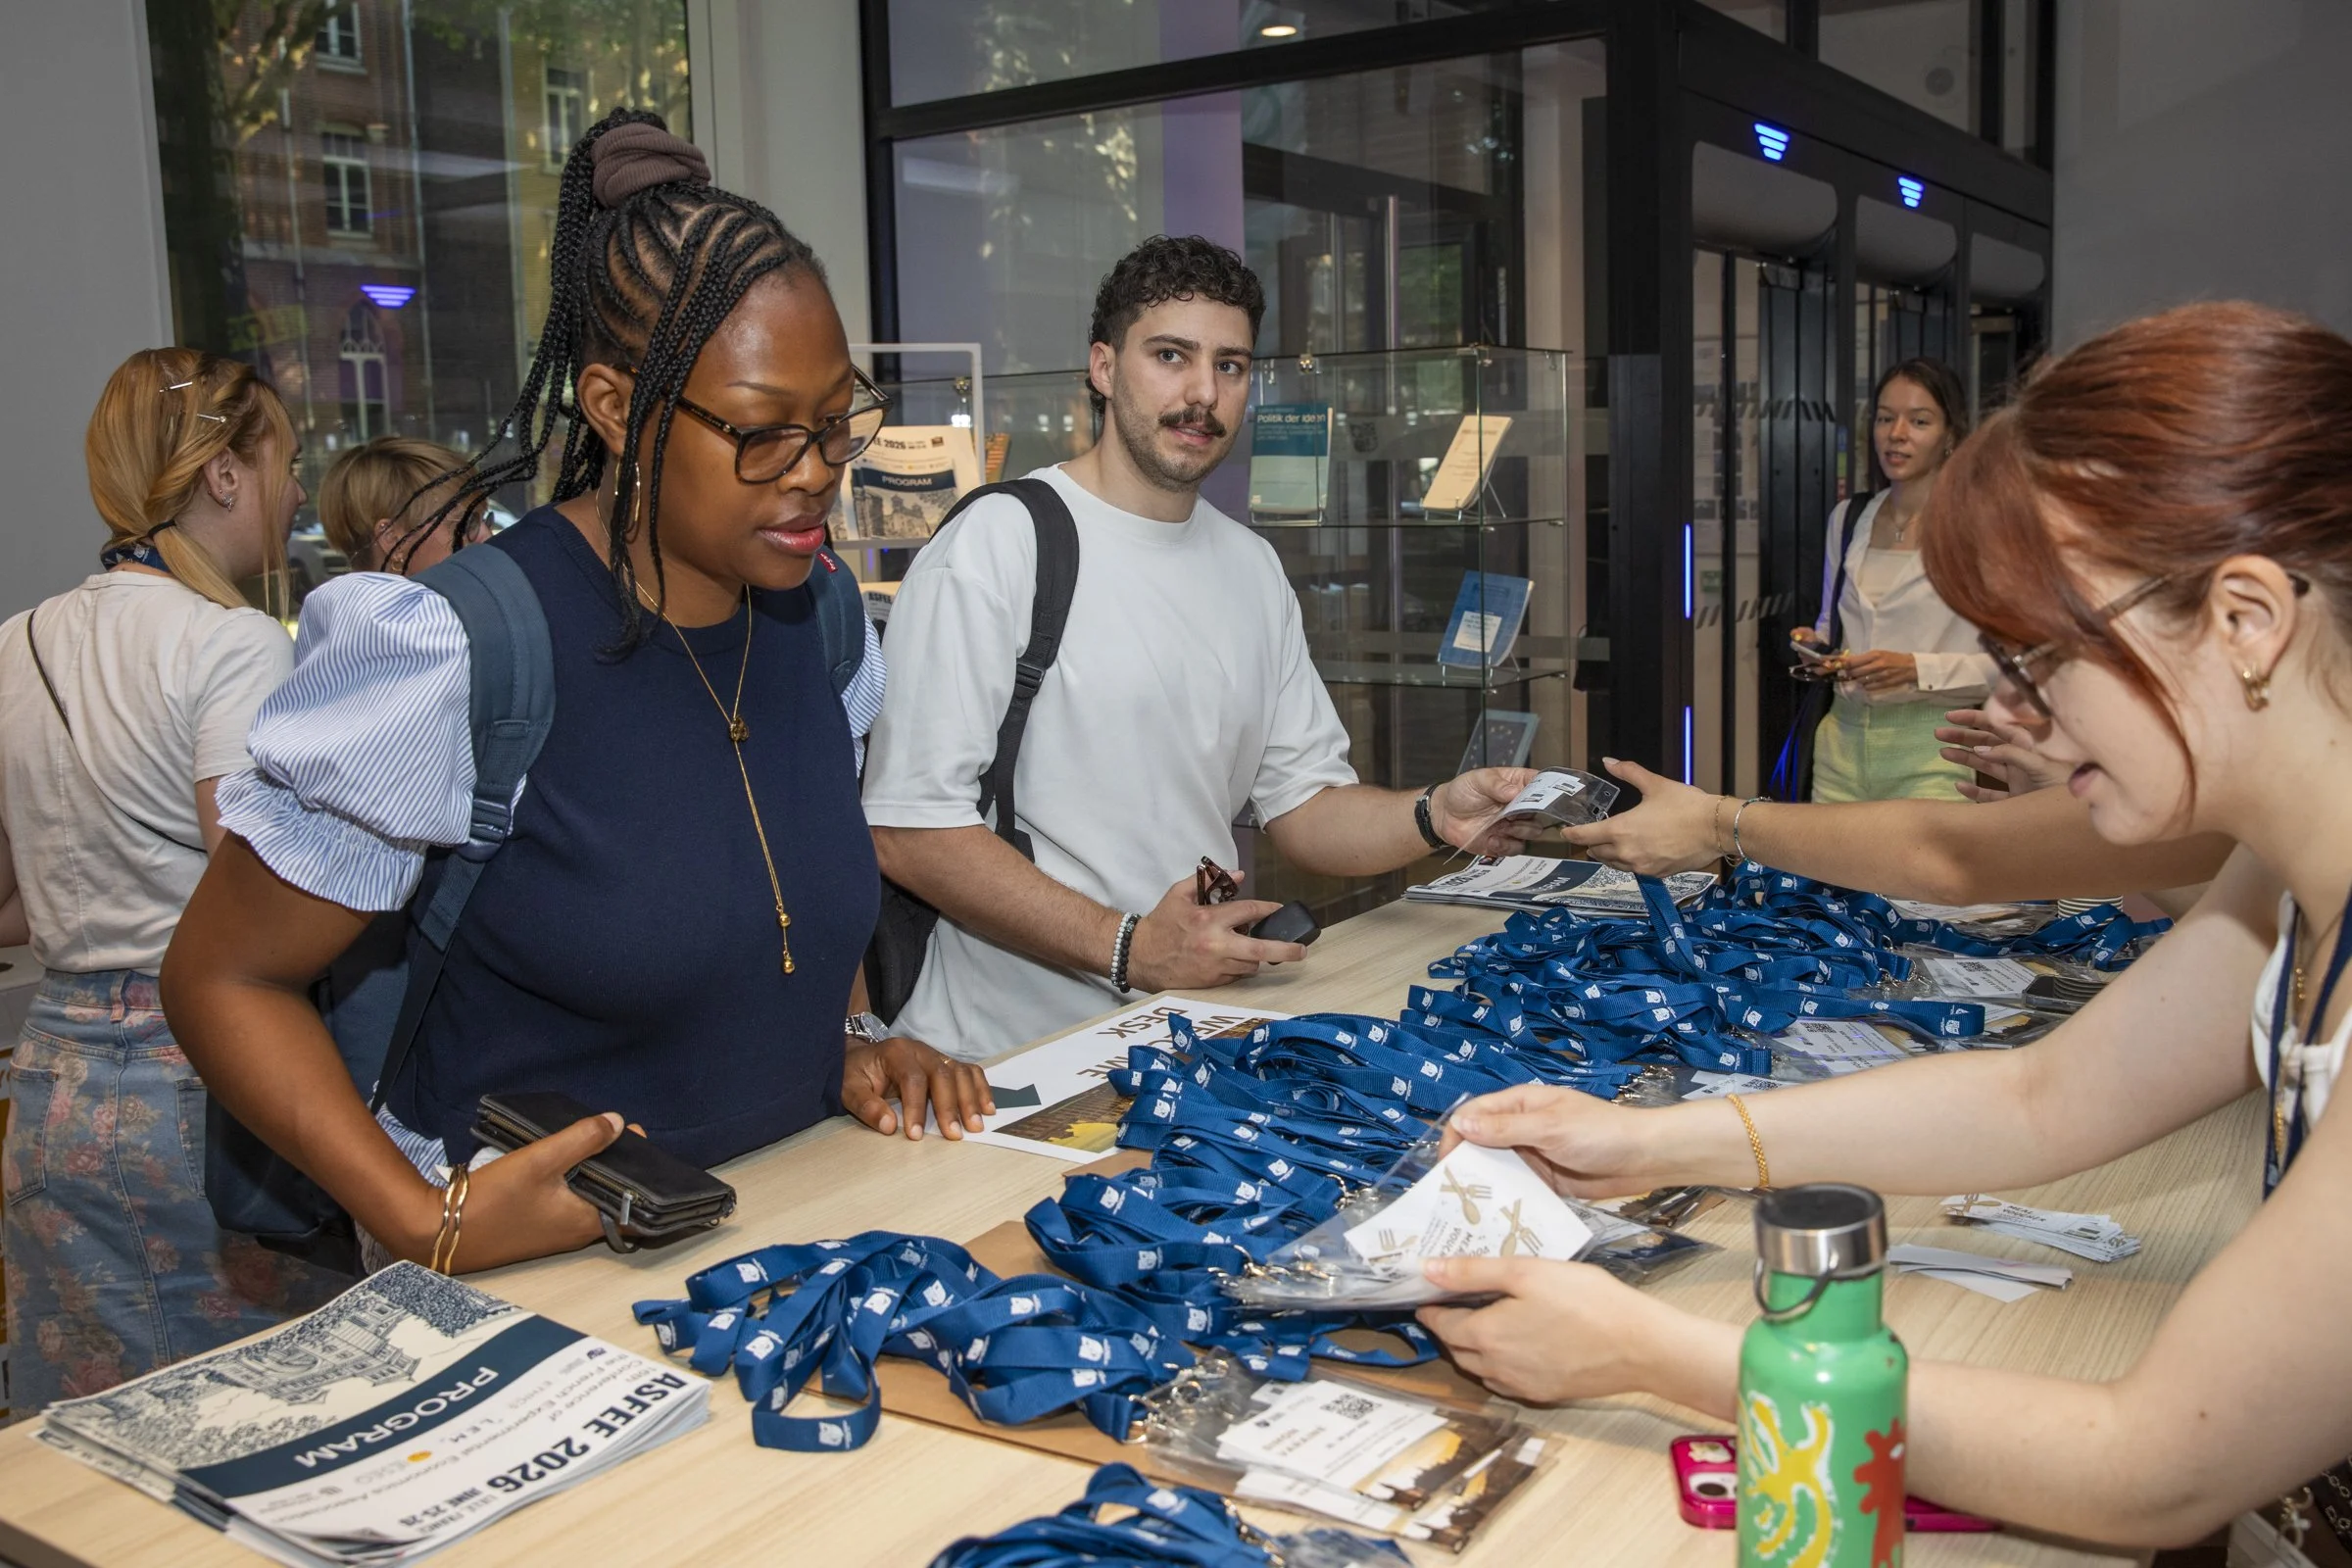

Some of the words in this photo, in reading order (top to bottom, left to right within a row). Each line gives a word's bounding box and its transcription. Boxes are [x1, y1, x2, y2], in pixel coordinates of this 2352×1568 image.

[1256, 414, 1284, 423] Politik
[1285, 414, 1300, 423] der
[883, 438, 906, 450] 2026
[881, 475, 933, 487] PROGRAM
[1096, 1006, 1189, 1039] DESK
[1076, 1014, 1245, 1080] WECME
[555, 1366, 606, 1399] French
[564, 1359, 644, 1409] Conference
[293, 1366, 500, 1468] PROGRAM
[549, 1409, 564, 1422] of
[581, 1372, 689, 1439] ASFEE
[461, 1398, 557, 1456] Experimental
[486, 1436, 590, 1494] 2026
[445, 1486, 483, 1508] JUNE
